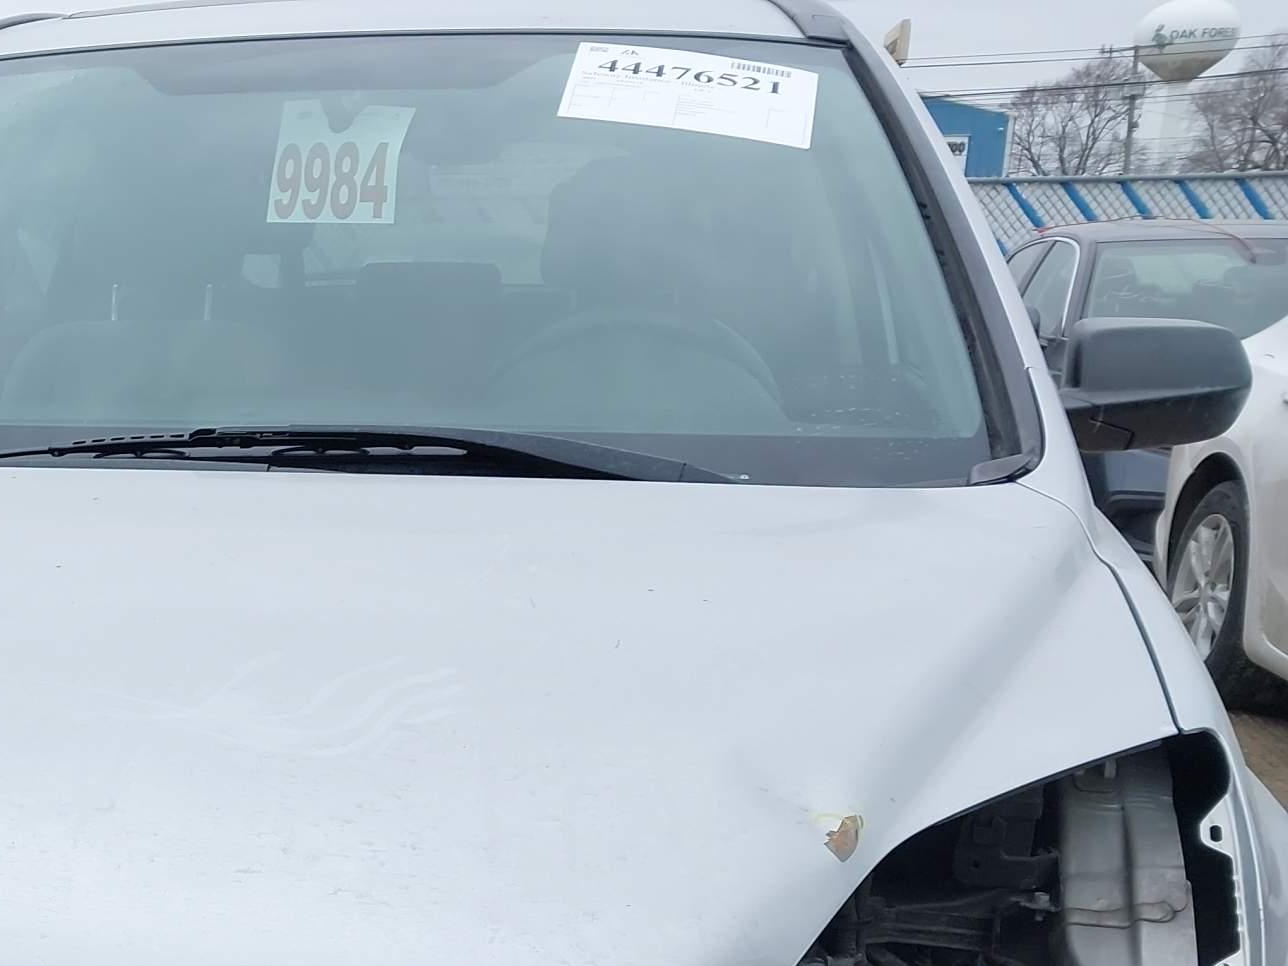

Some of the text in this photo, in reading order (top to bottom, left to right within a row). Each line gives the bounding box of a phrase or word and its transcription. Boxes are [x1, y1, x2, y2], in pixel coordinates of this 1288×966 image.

[1170, 28, 1199, 40] OAK
[598, 58, 781, 94] 44476521
[274, 141, 389, 219] 9984
